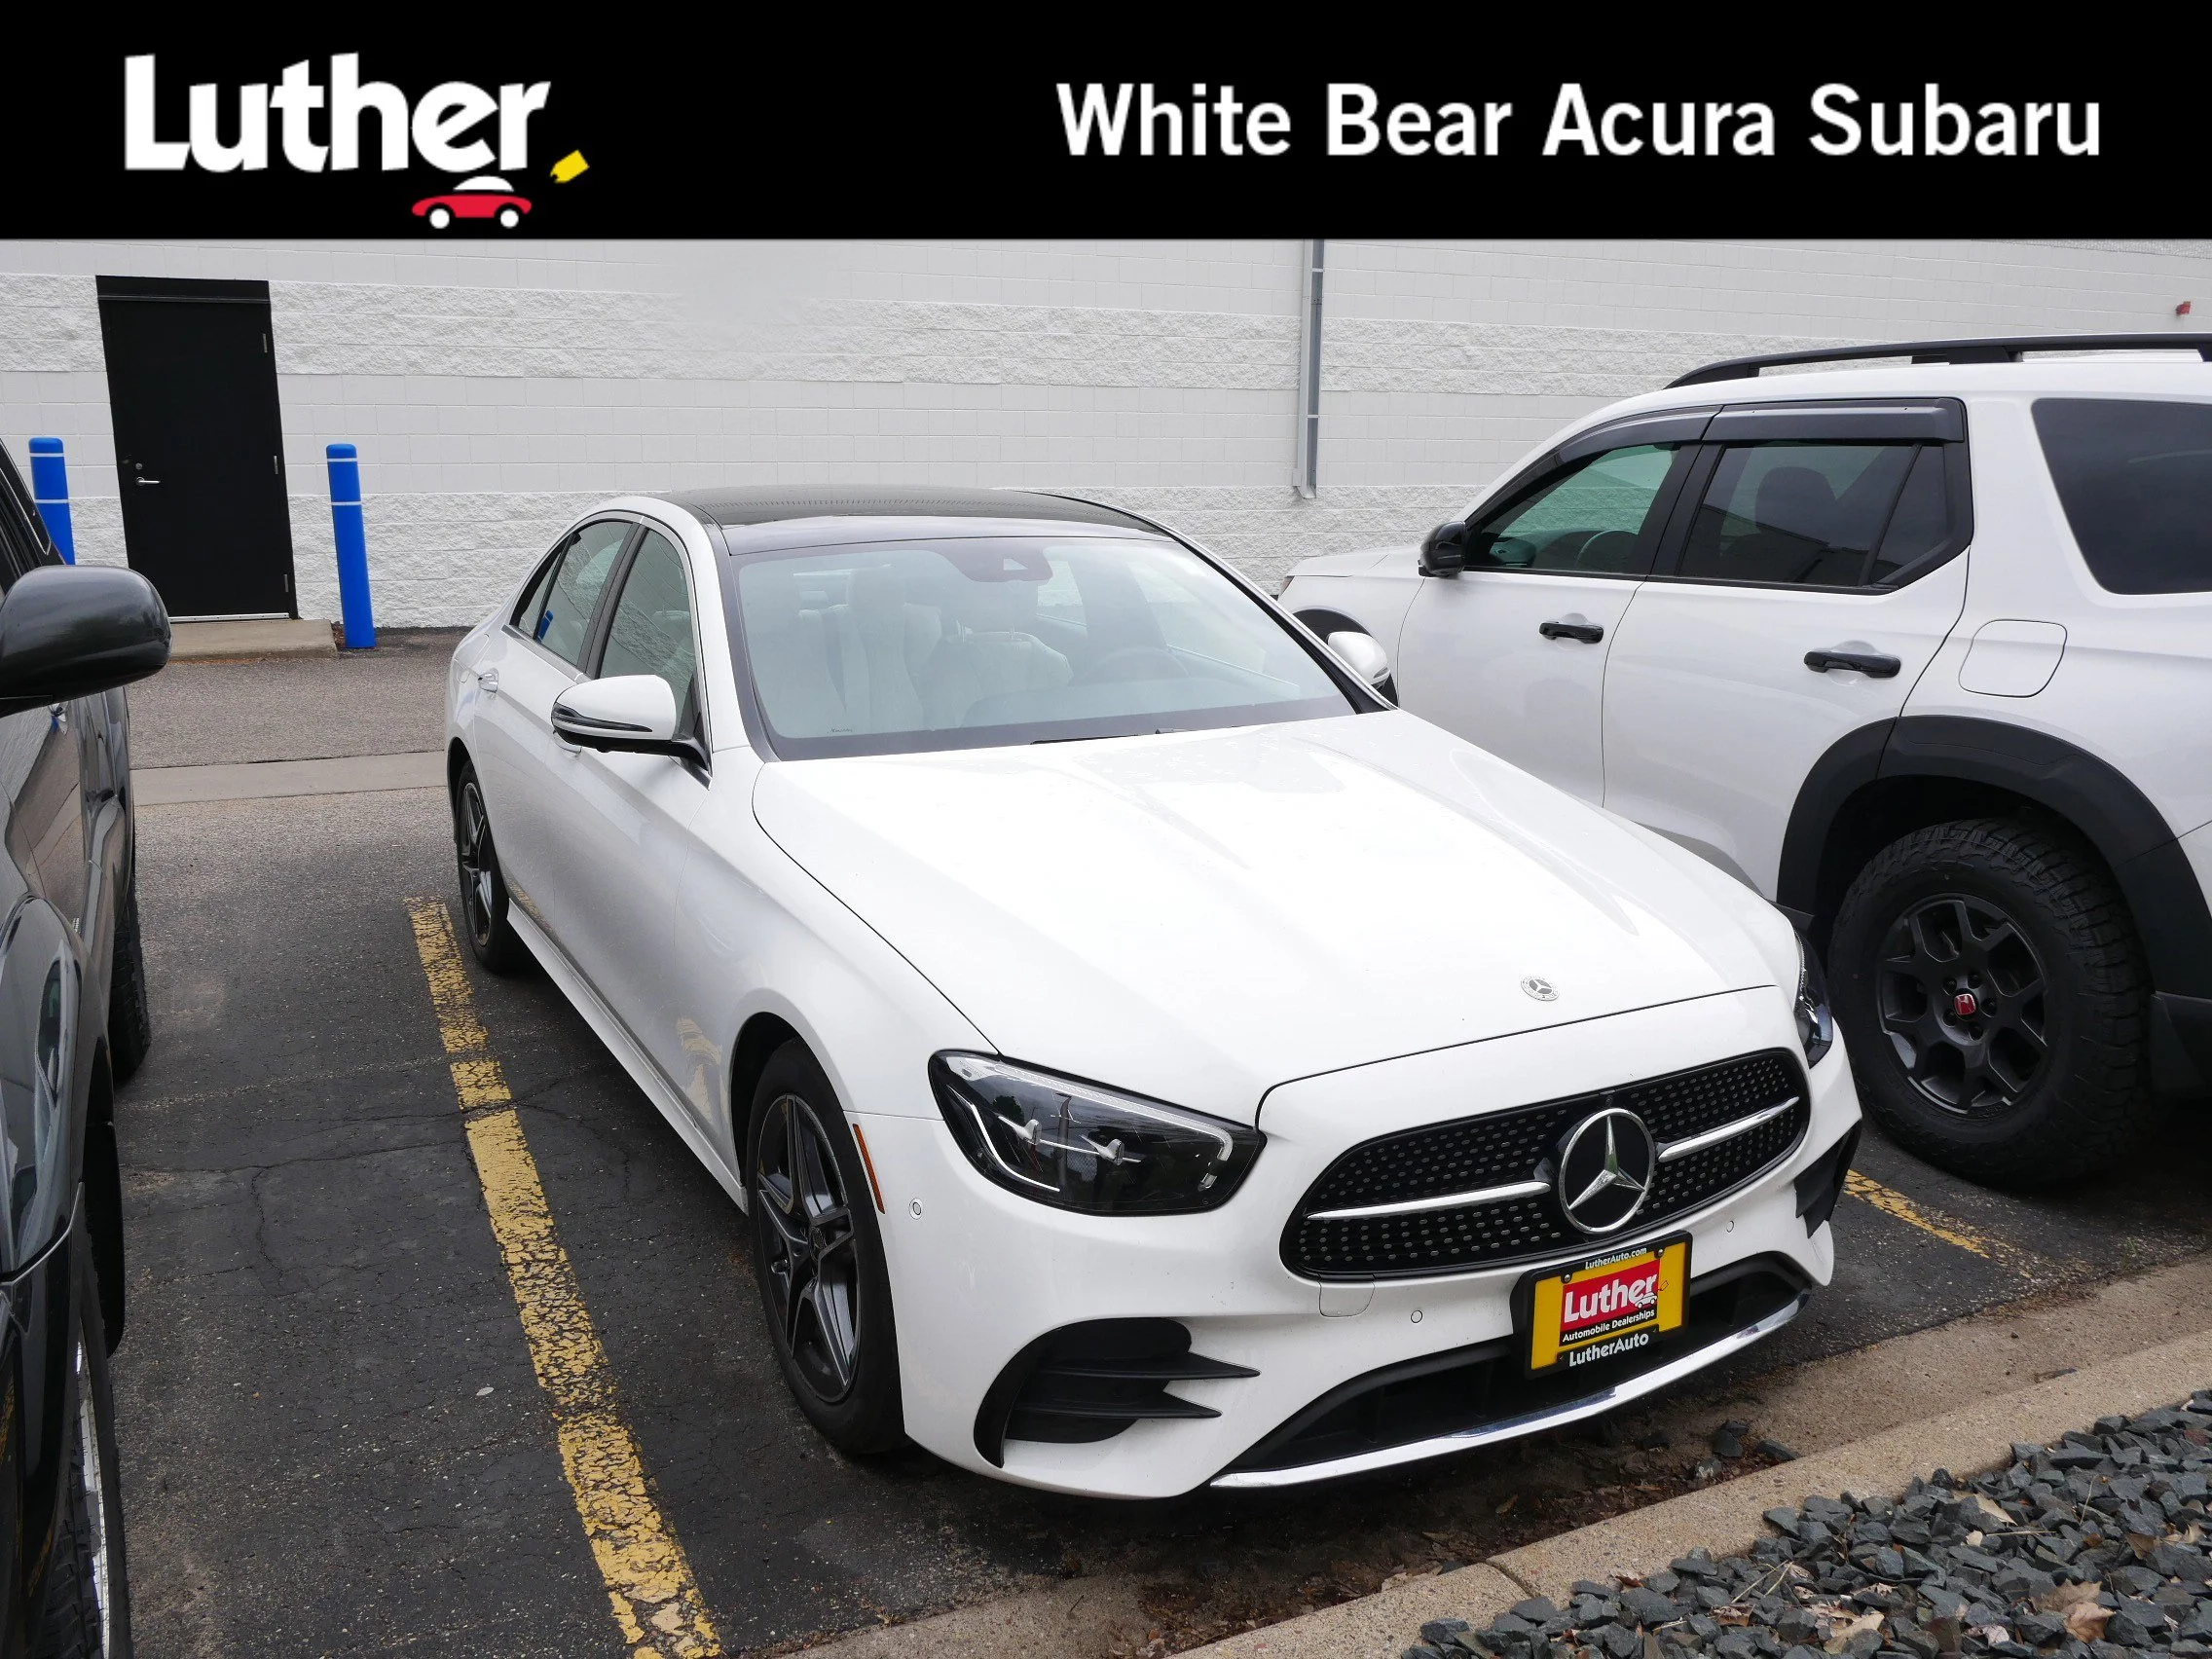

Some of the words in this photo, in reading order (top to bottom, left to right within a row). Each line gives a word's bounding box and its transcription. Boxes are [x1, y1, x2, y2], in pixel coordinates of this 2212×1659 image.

[1585, 1247, 1647, 1270] LutherAuto.com
[1564, 1273, 1658, 1323] Luther
[1562, 1323, 1610, 1343] Automobile
[1611, 1309, 1655, 1328] Dealerships
[1568, 1333, 1649, 1367] LutherAuto
